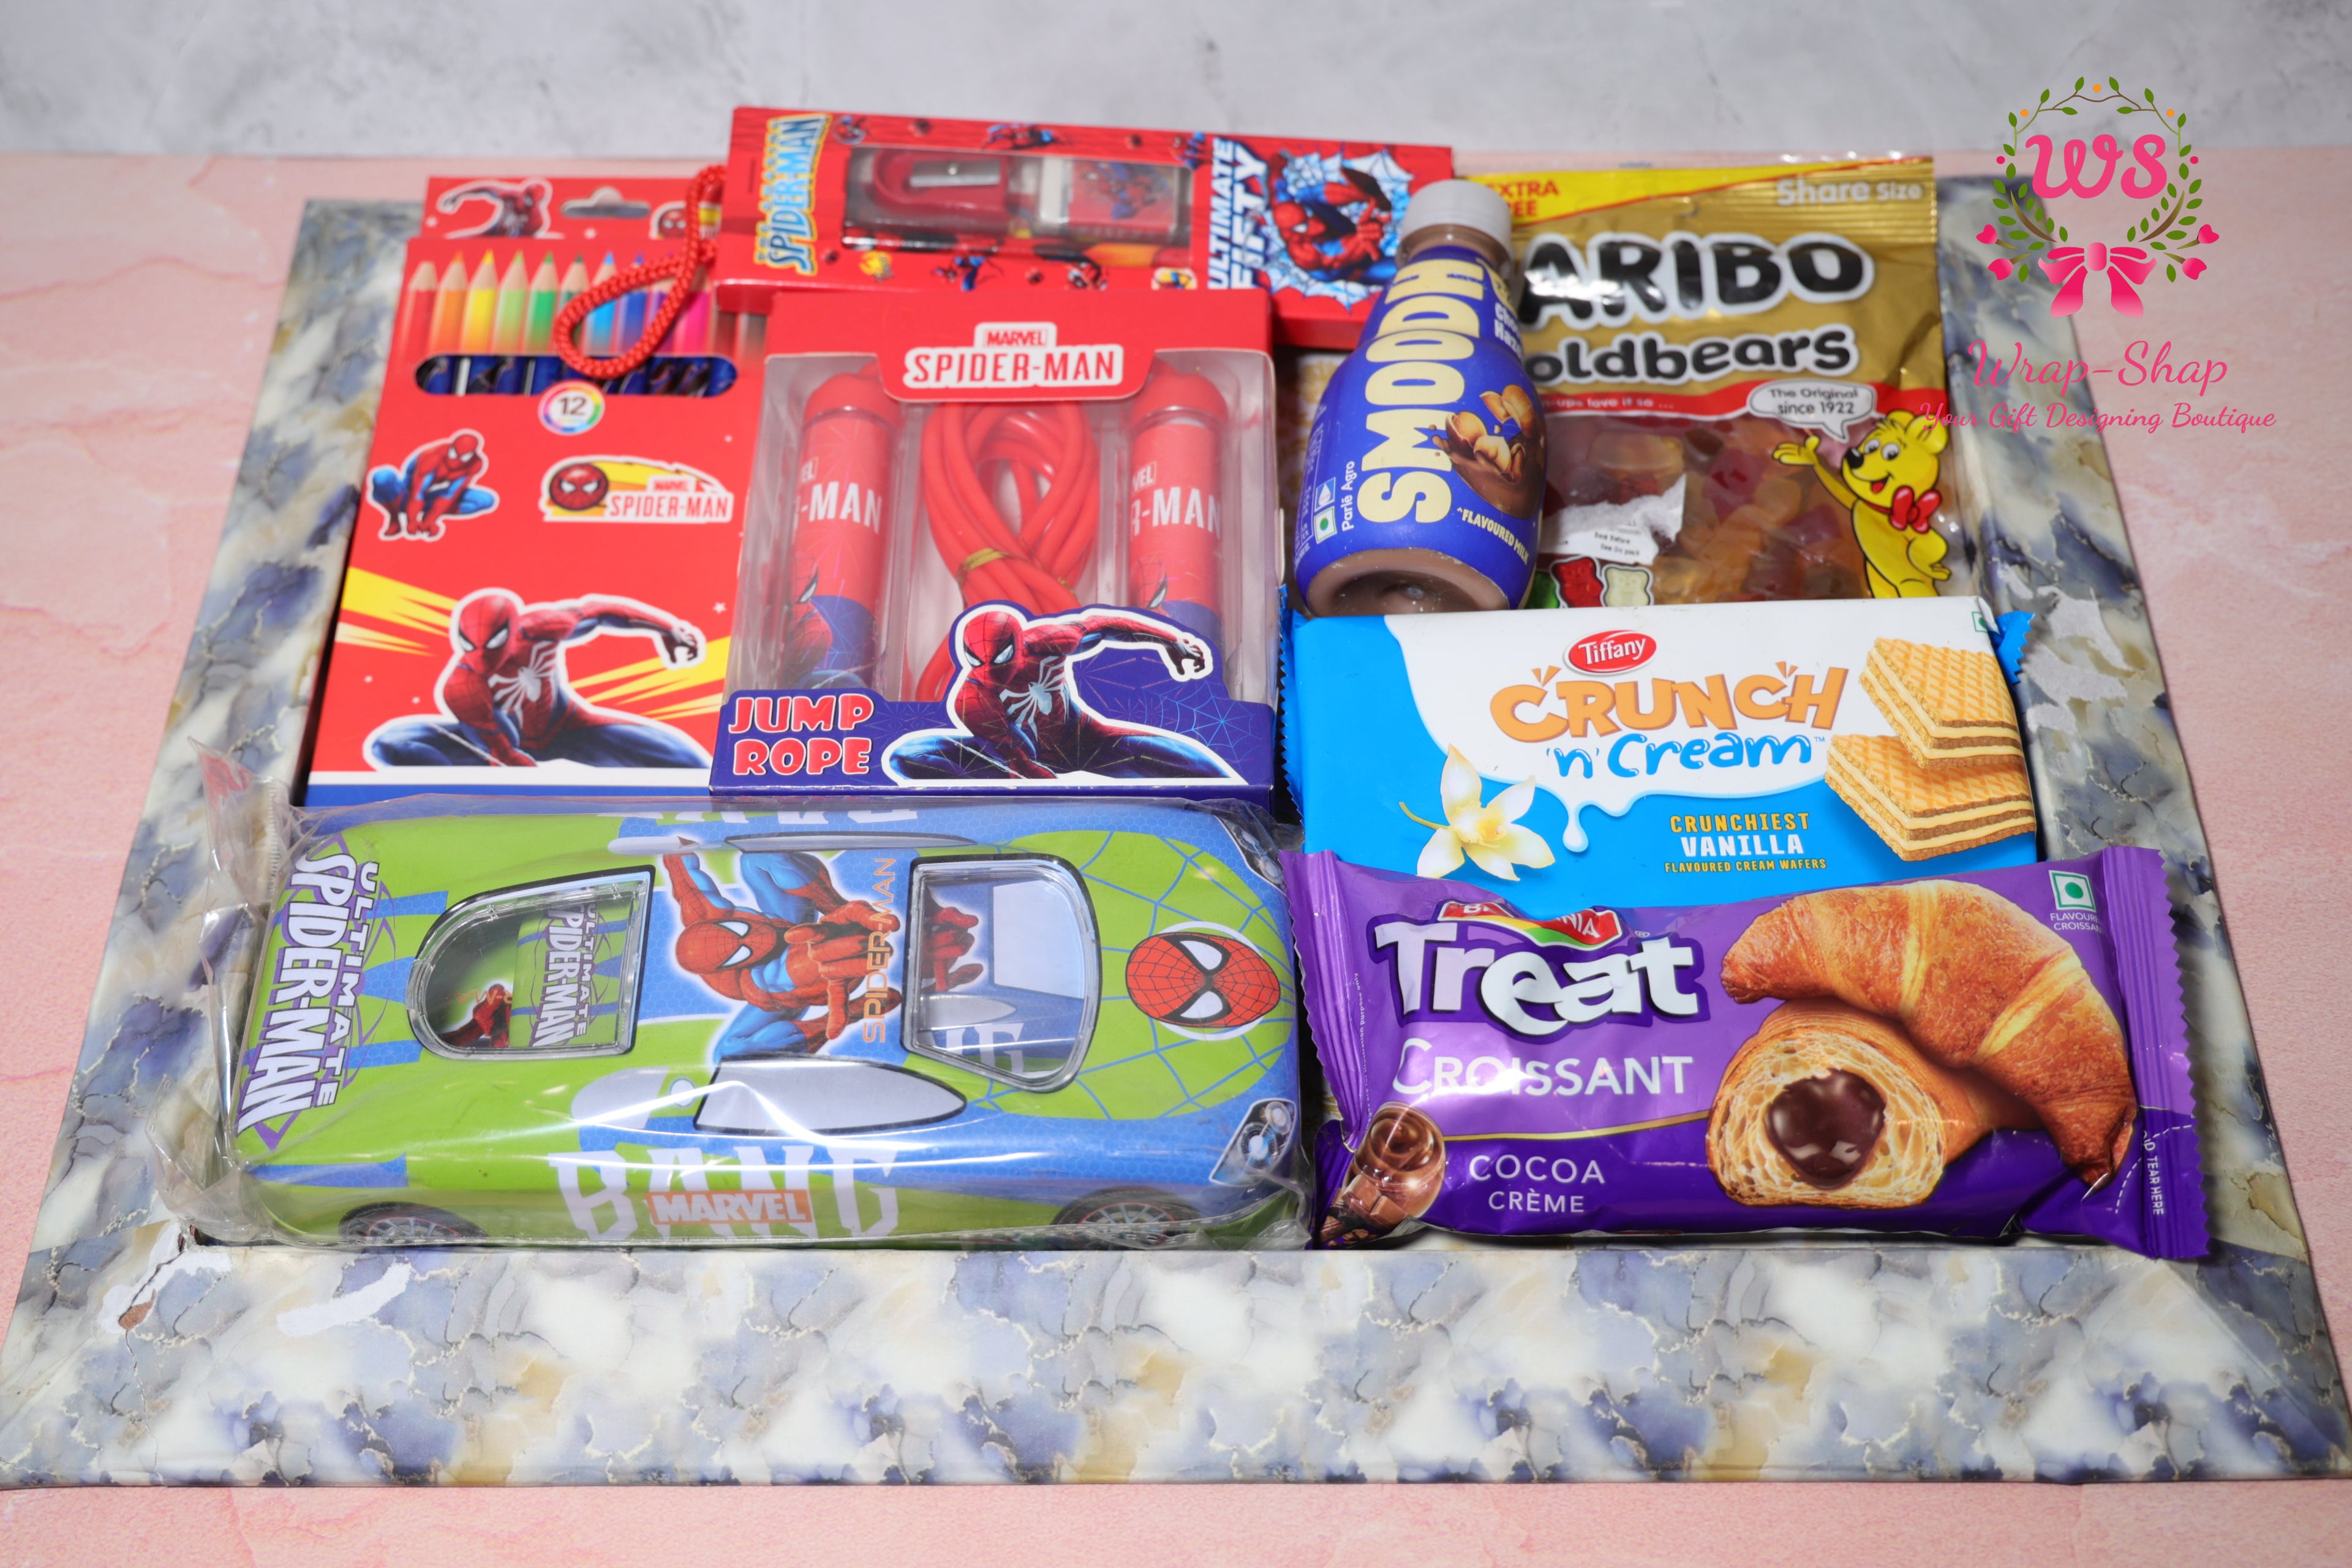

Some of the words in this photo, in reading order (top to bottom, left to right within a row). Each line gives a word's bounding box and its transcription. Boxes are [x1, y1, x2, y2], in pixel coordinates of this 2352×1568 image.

[1775, 178, 1871, 206] Share
[1518, 234, 1869, 328] ARIBO
[987, 331, 1044, 346] MARVEL
[912, 350, 1117, 383] SPIDER-MAN
[1526, 326, 1858, 386] oldbears
[559, 396, 587, 416] 12
[1357, 258, 1486, 524] SMOODH
[1770, 388, 1796, 398] The
[1800, 388, 1858, 401] Original
[1777, 401, 1815, 414] since
[1820, 402, 1855, 414] 1922
[1340, 461, 1358, 491] Agro
[610, 495, 728, 518] SPIDER-MAN
[1513, 539, 1529, 565] MILK
[1578, 638, 1646, 665] Tiffany
[729, 693, 875, 734] JUMP
[1490, 663, 1849, 743] CRUNCH
[733, 737, 873, 775] ROPE
[1607, 732, 1812, 777] Cream
[1669, 812, 1809, 833] CRUNCHIEST
[1680, 834, 1804, 858] VANILLA
[1664, 862, 1732, 873] FLAVOURED
[1735, 860, 1775, 872] CREAM
[1779, 859, 1827, 870] WAFERS
[862, 858, 896, 1044] SPIDER-MAN
[314, 861, 379, 1107] ULTIMATE
[532, 905, 584, 1047] PIDER-MAN
[1374, 921, 1698, 1036] Treat
[236, 853, 355, 1135] SPIDER-MAN
[1357, 993, 1366, 1025] purpose
[1392, 1038, 1693, 1095] CROISSANT
[1469, 1154, 1605, 1184] COCOA
[2147, 1155, 2160, 1184] TEAR
[652, 1193, 808, 1224] MARVEL
[1488, 1188, 1585, 1213] CRÈME
[2150, 1185, 2164, 1215] HERE
